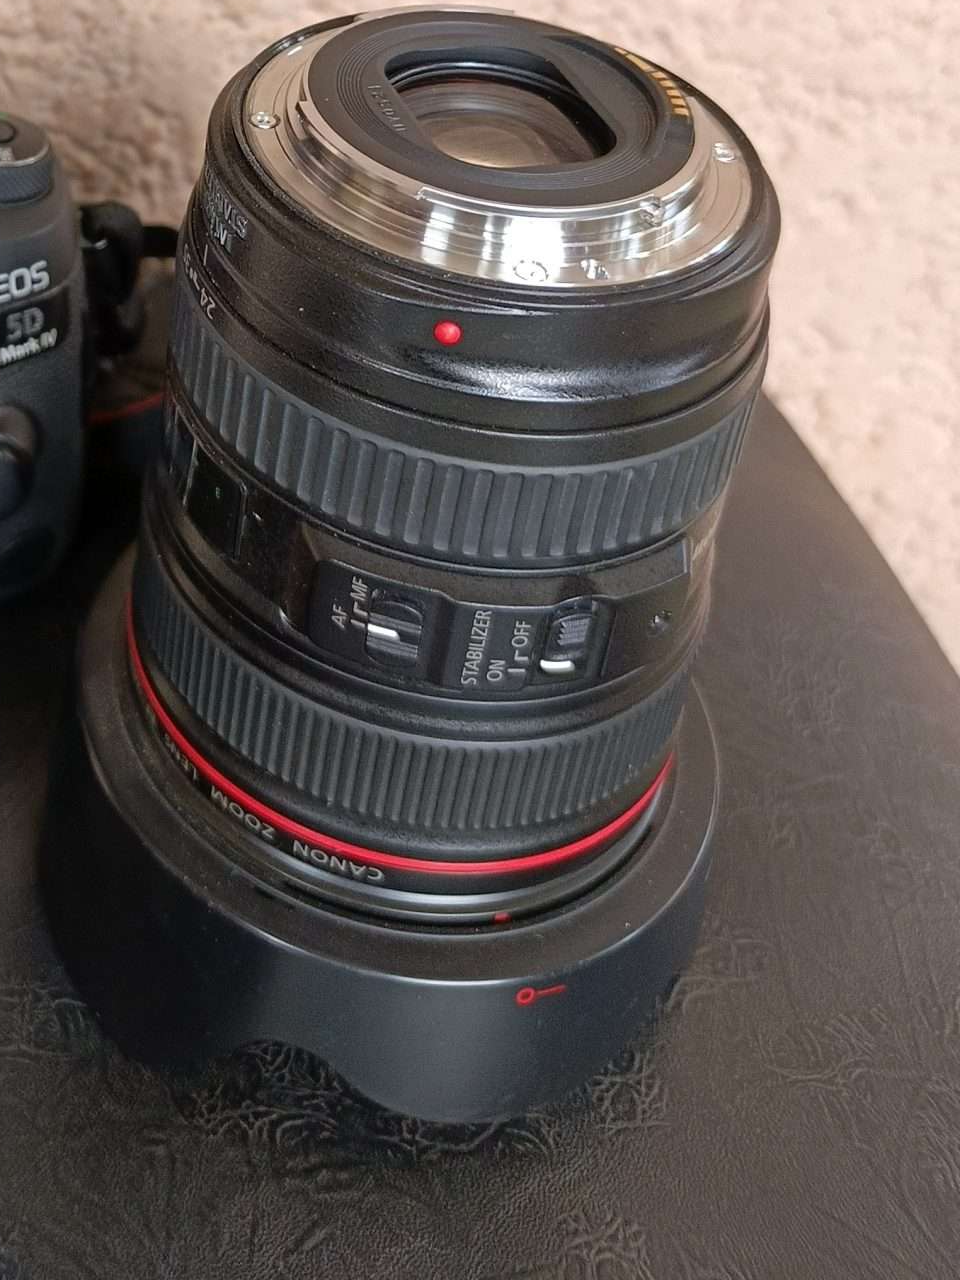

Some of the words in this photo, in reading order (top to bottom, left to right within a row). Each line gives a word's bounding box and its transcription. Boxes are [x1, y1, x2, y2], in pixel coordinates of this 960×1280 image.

[200, 287, 217, 320] 24
[5, 307, 45, 341] 5D
[349, 576, 369, 601] MF
[330, 603, 348, 630] AF
[461, 609, 492, 686] STABILIZER
[511, 620, 533, 648] OFF
[486, 659, 506, 682] ON
[210, 785, 277, 840] ZOOM
[292, 839, 385, 881] CANON
